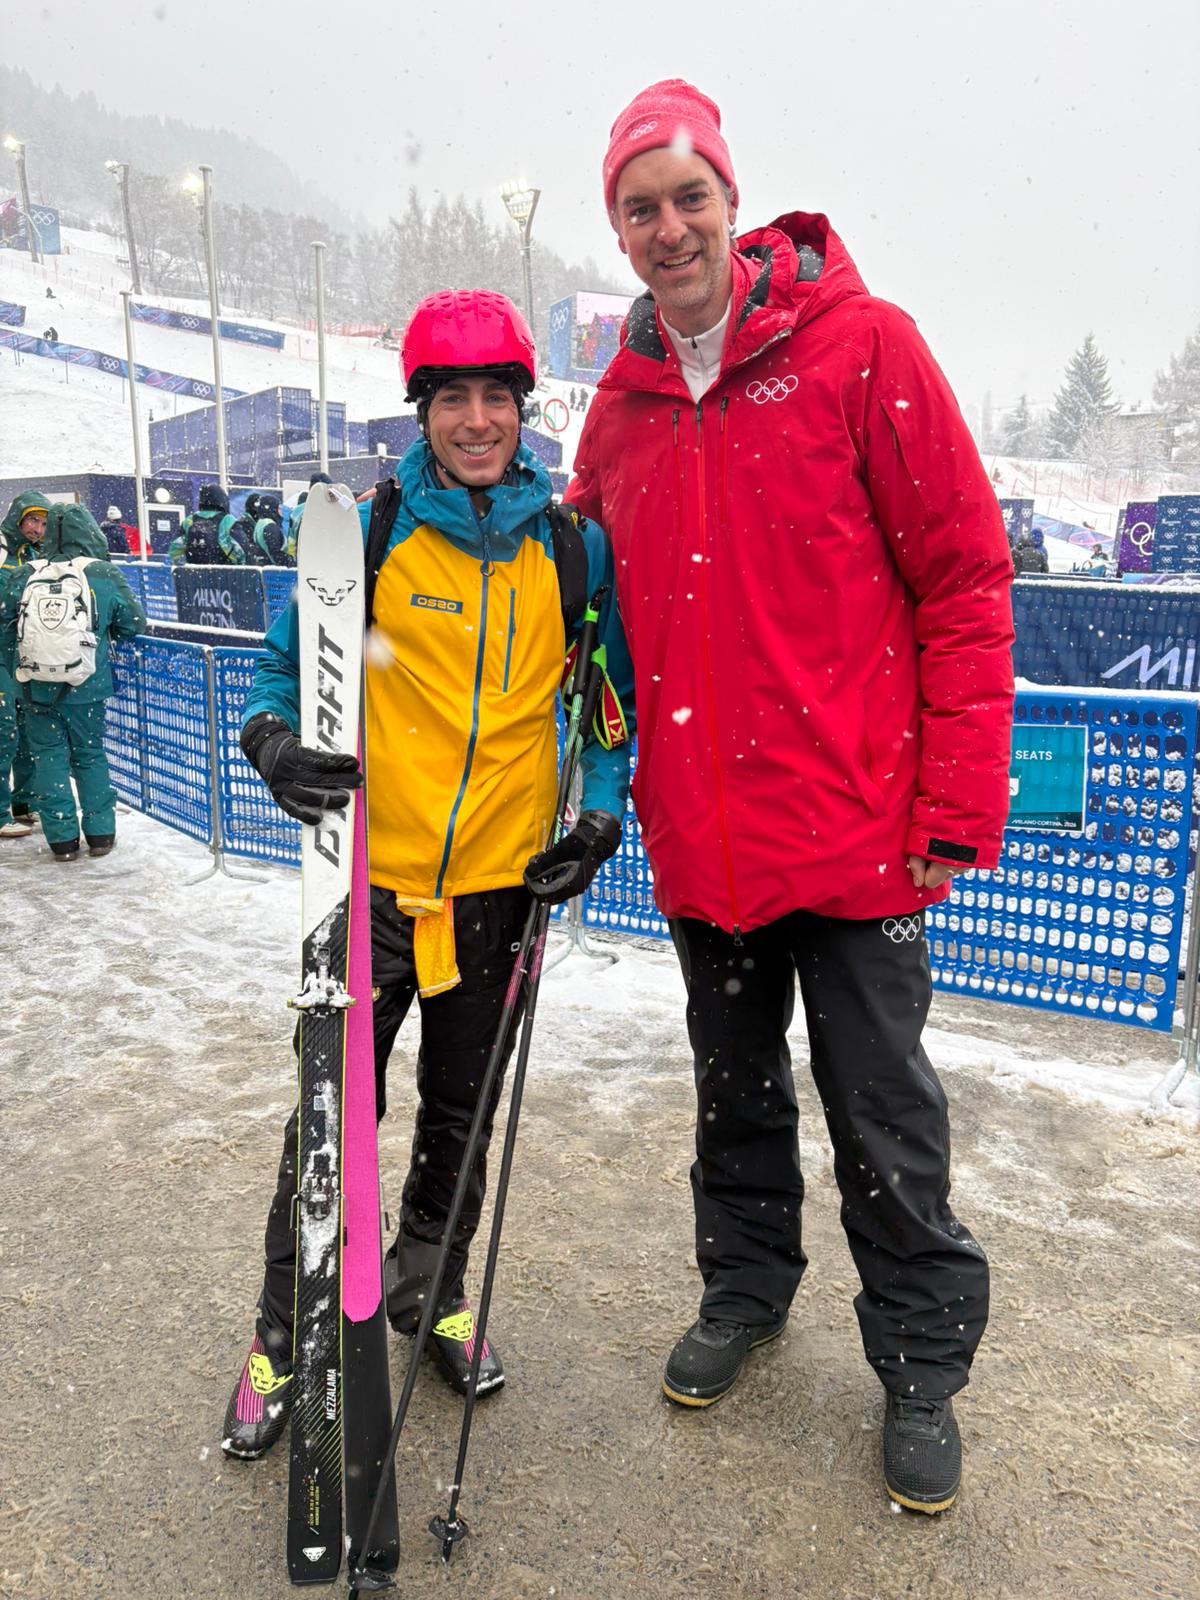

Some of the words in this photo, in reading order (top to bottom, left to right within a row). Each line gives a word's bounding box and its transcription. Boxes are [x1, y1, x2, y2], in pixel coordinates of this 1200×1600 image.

[1101, 644, 1200, 689] MI
[315, 622, 346, 868] DAFIT
[1015, 749, 1053, 761] SEATS
[326, 1369, 337, 1420] MEZZALAMA
